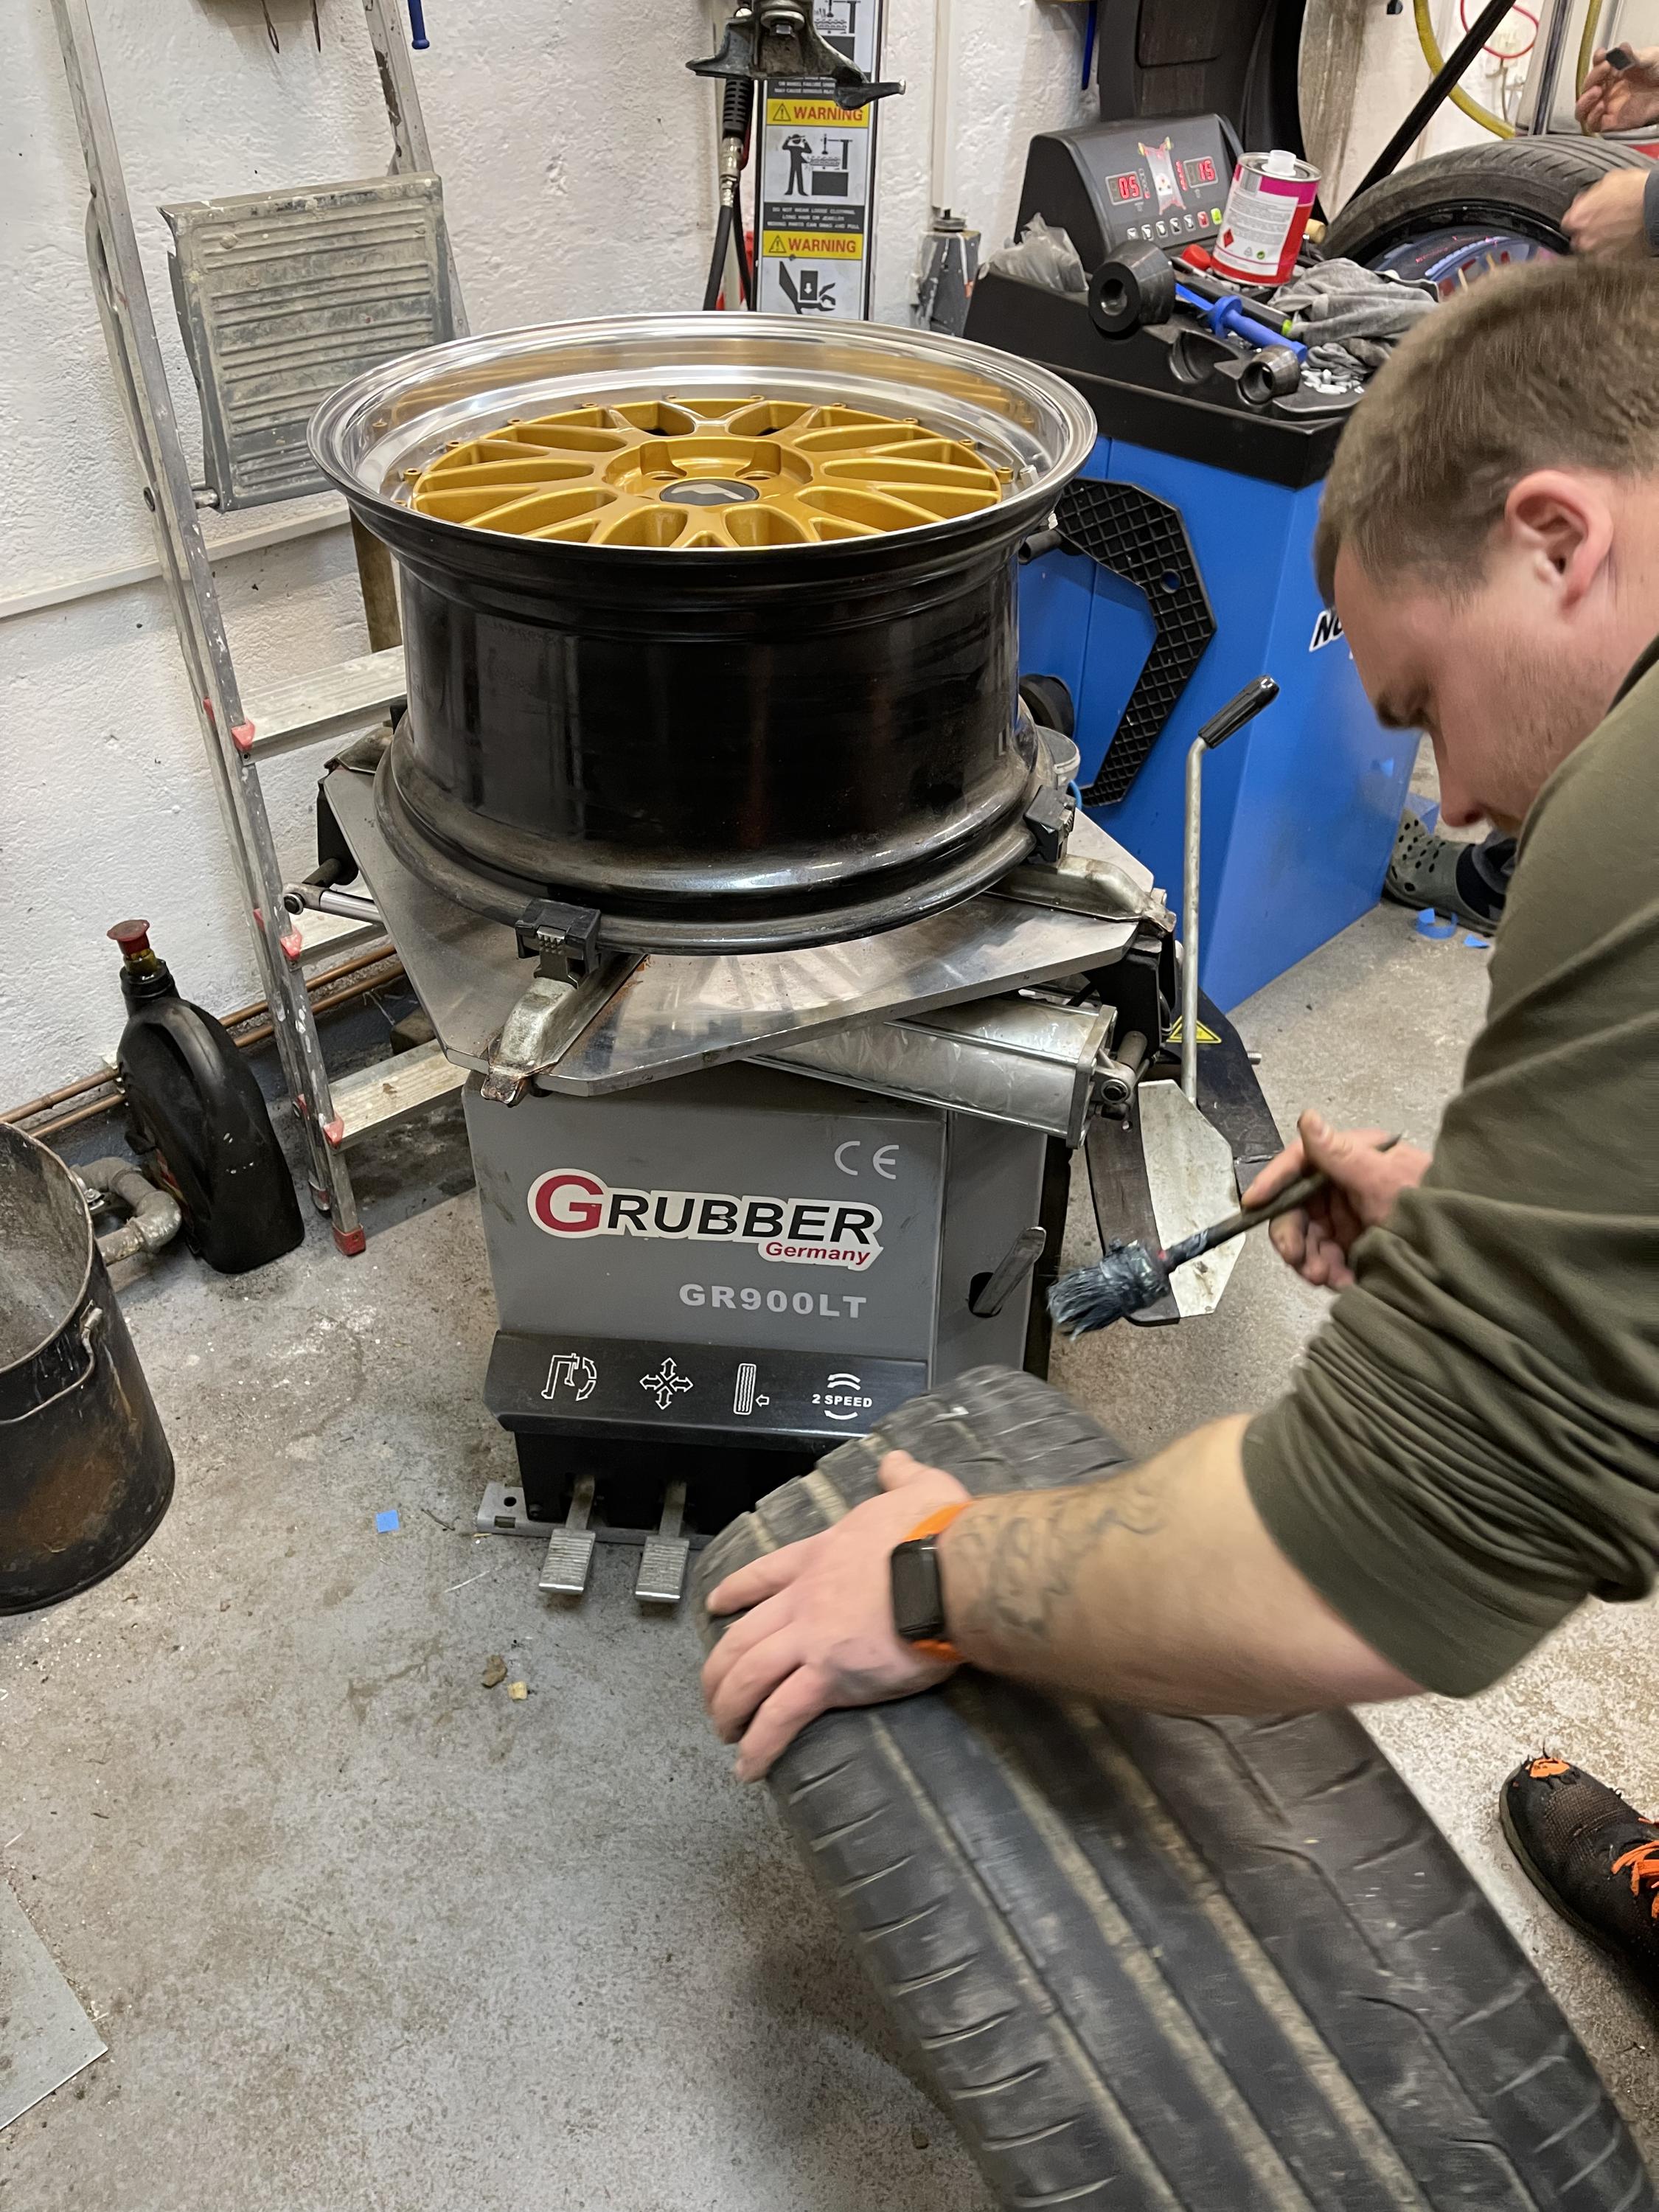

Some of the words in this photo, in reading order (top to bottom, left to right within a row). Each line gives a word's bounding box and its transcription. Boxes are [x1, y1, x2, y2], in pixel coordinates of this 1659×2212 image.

[793, 105, 863, 121] WARNING
[1198, 159, 1215, 181] 15
[1119, 175, 1140, 200] 05
[788, 237, 856, 253] WARNING
[535, 1175, 875, 1245] GRUBBER
[765, 1242, 871, 1265] Germany
[679, 1284, 867, 1318] GR900LT
[812, 1394, 821, 1404] 2
[824, 1394, 872, 1408] SPEED
